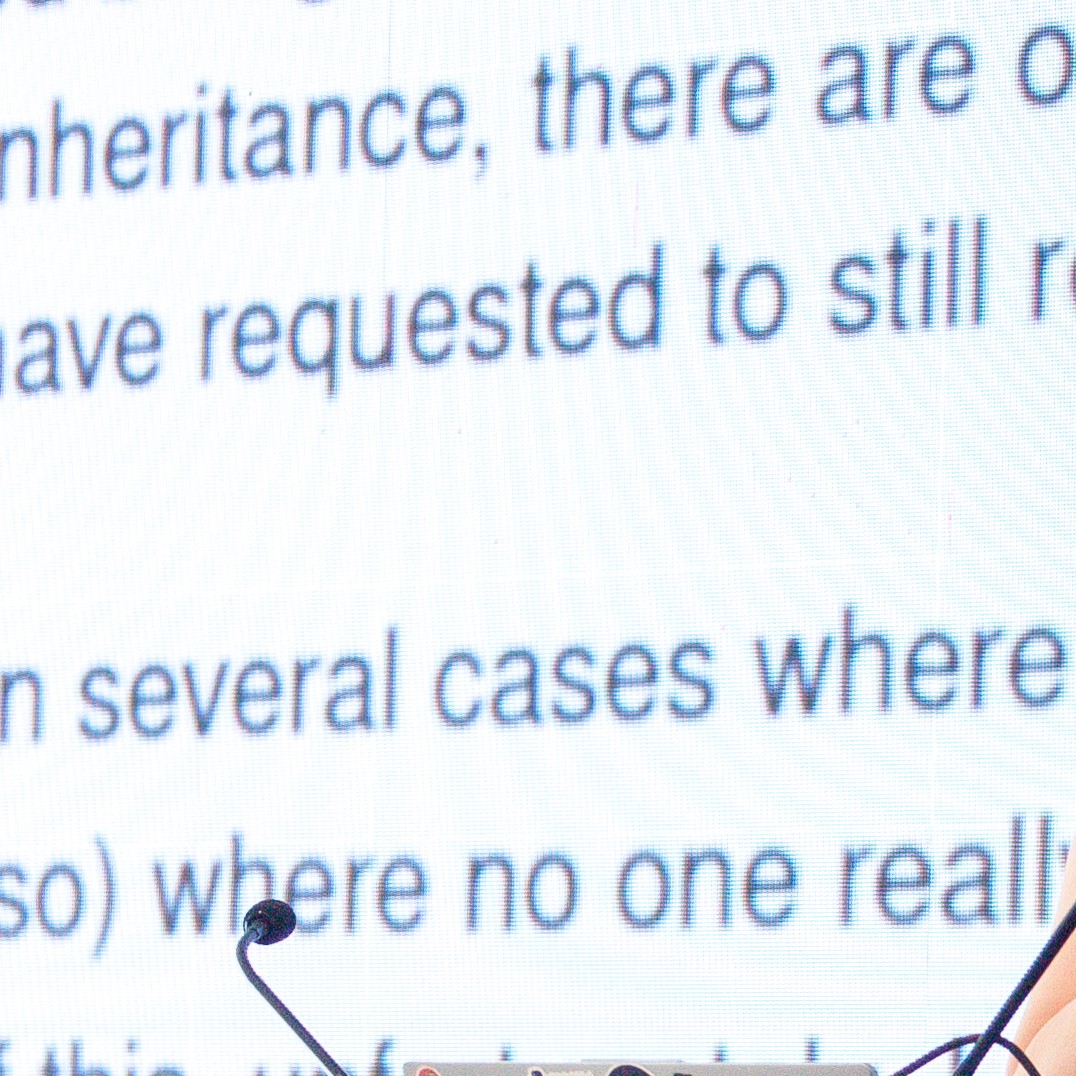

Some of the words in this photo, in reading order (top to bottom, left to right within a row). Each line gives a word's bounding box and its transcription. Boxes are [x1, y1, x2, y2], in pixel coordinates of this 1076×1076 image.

[534, 45, 775, 152] there
[817, 36, 973, 126] are
[0, 312, 161, 397] ave
[203, 242, 663, 399] requested
[704, 245, 789, 344] to
[829, 214, 988, 338] still
[79, 626, 400, 741] several
[436, 640, 714, 729] cases
[755, 601, 1067, 715] where
[154, 831, 428, 936] where
[467, 850, 580, 932] no
[618, 847, 799, 931] one
[840, 812, 1071, 927] reall
